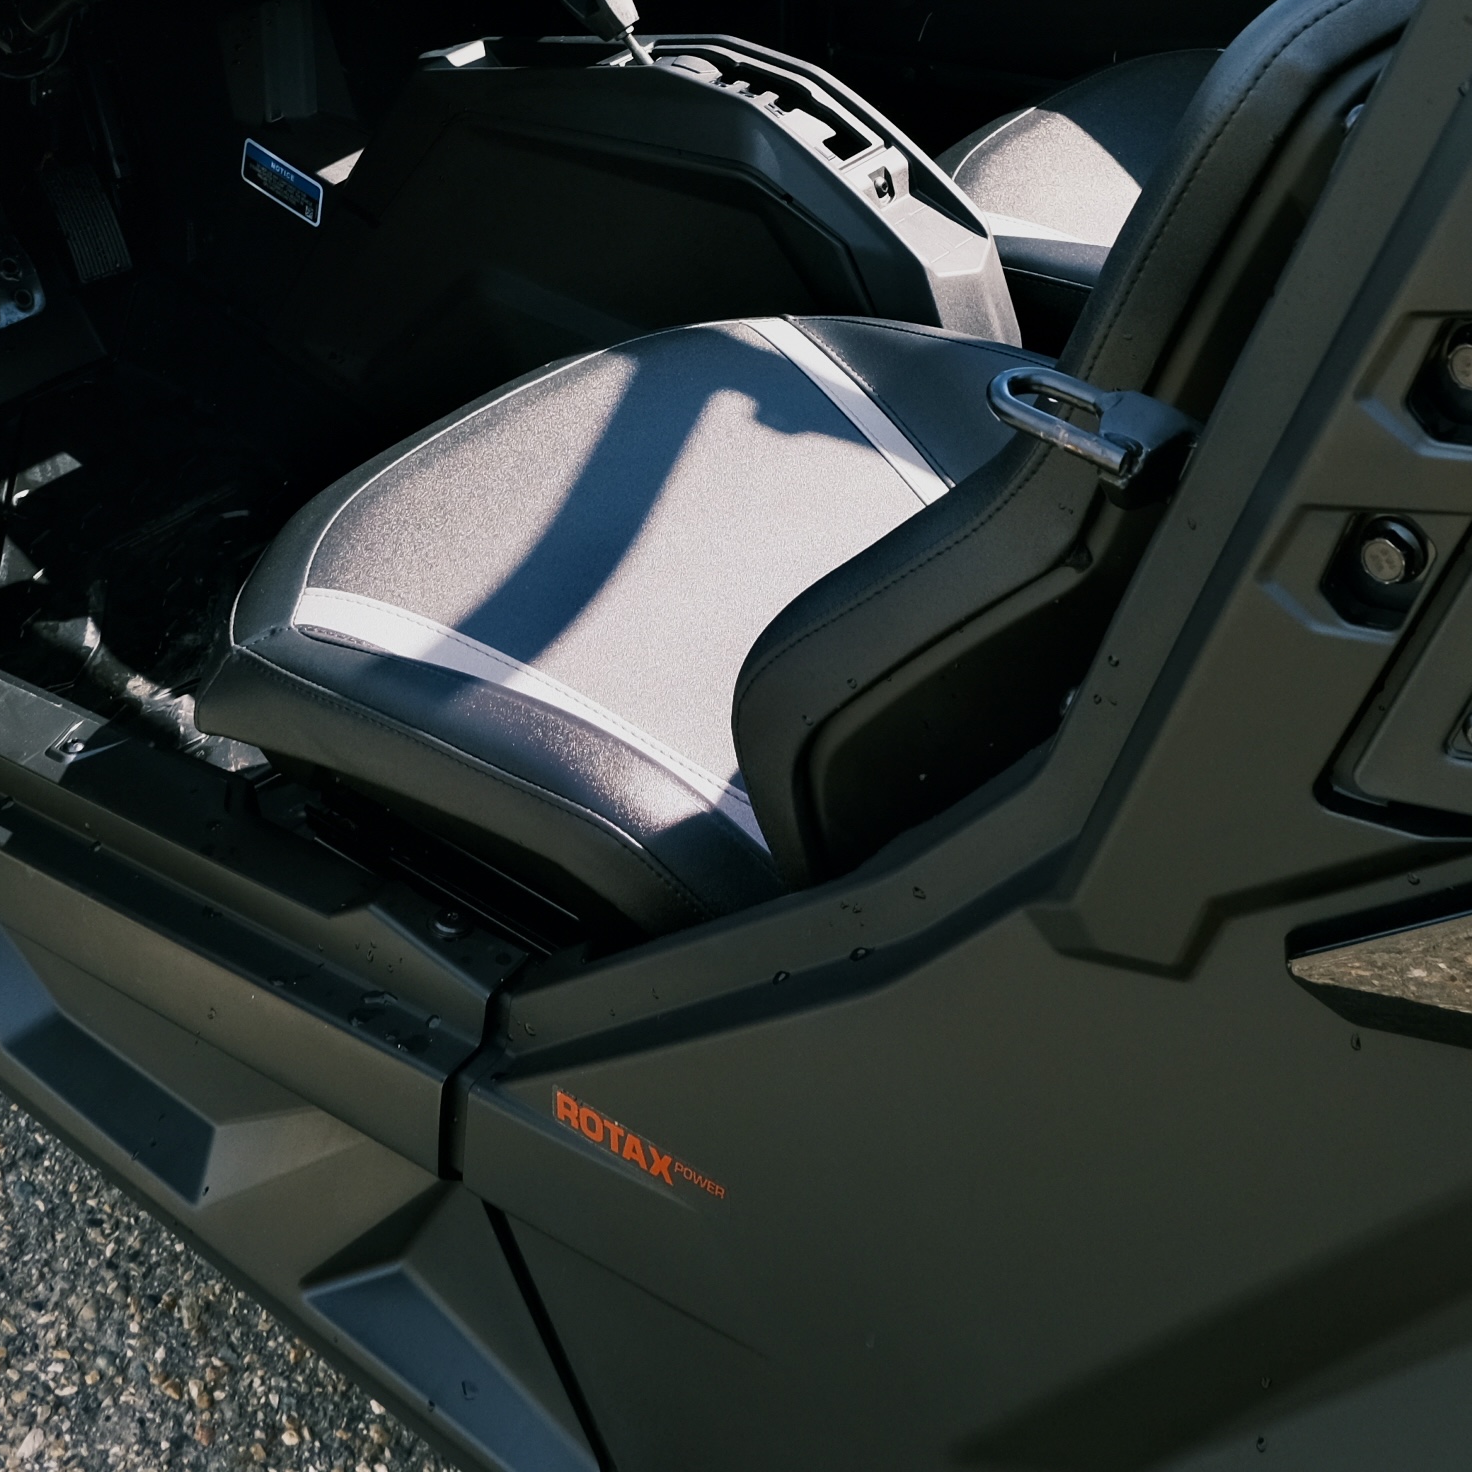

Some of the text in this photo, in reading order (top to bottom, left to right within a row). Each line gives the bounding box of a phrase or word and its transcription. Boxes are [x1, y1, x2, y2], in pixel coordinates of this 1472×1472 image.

[270, 161, 295, 182] NOTICE
[556, 1090, 726, 1200] ROTAX POWER
